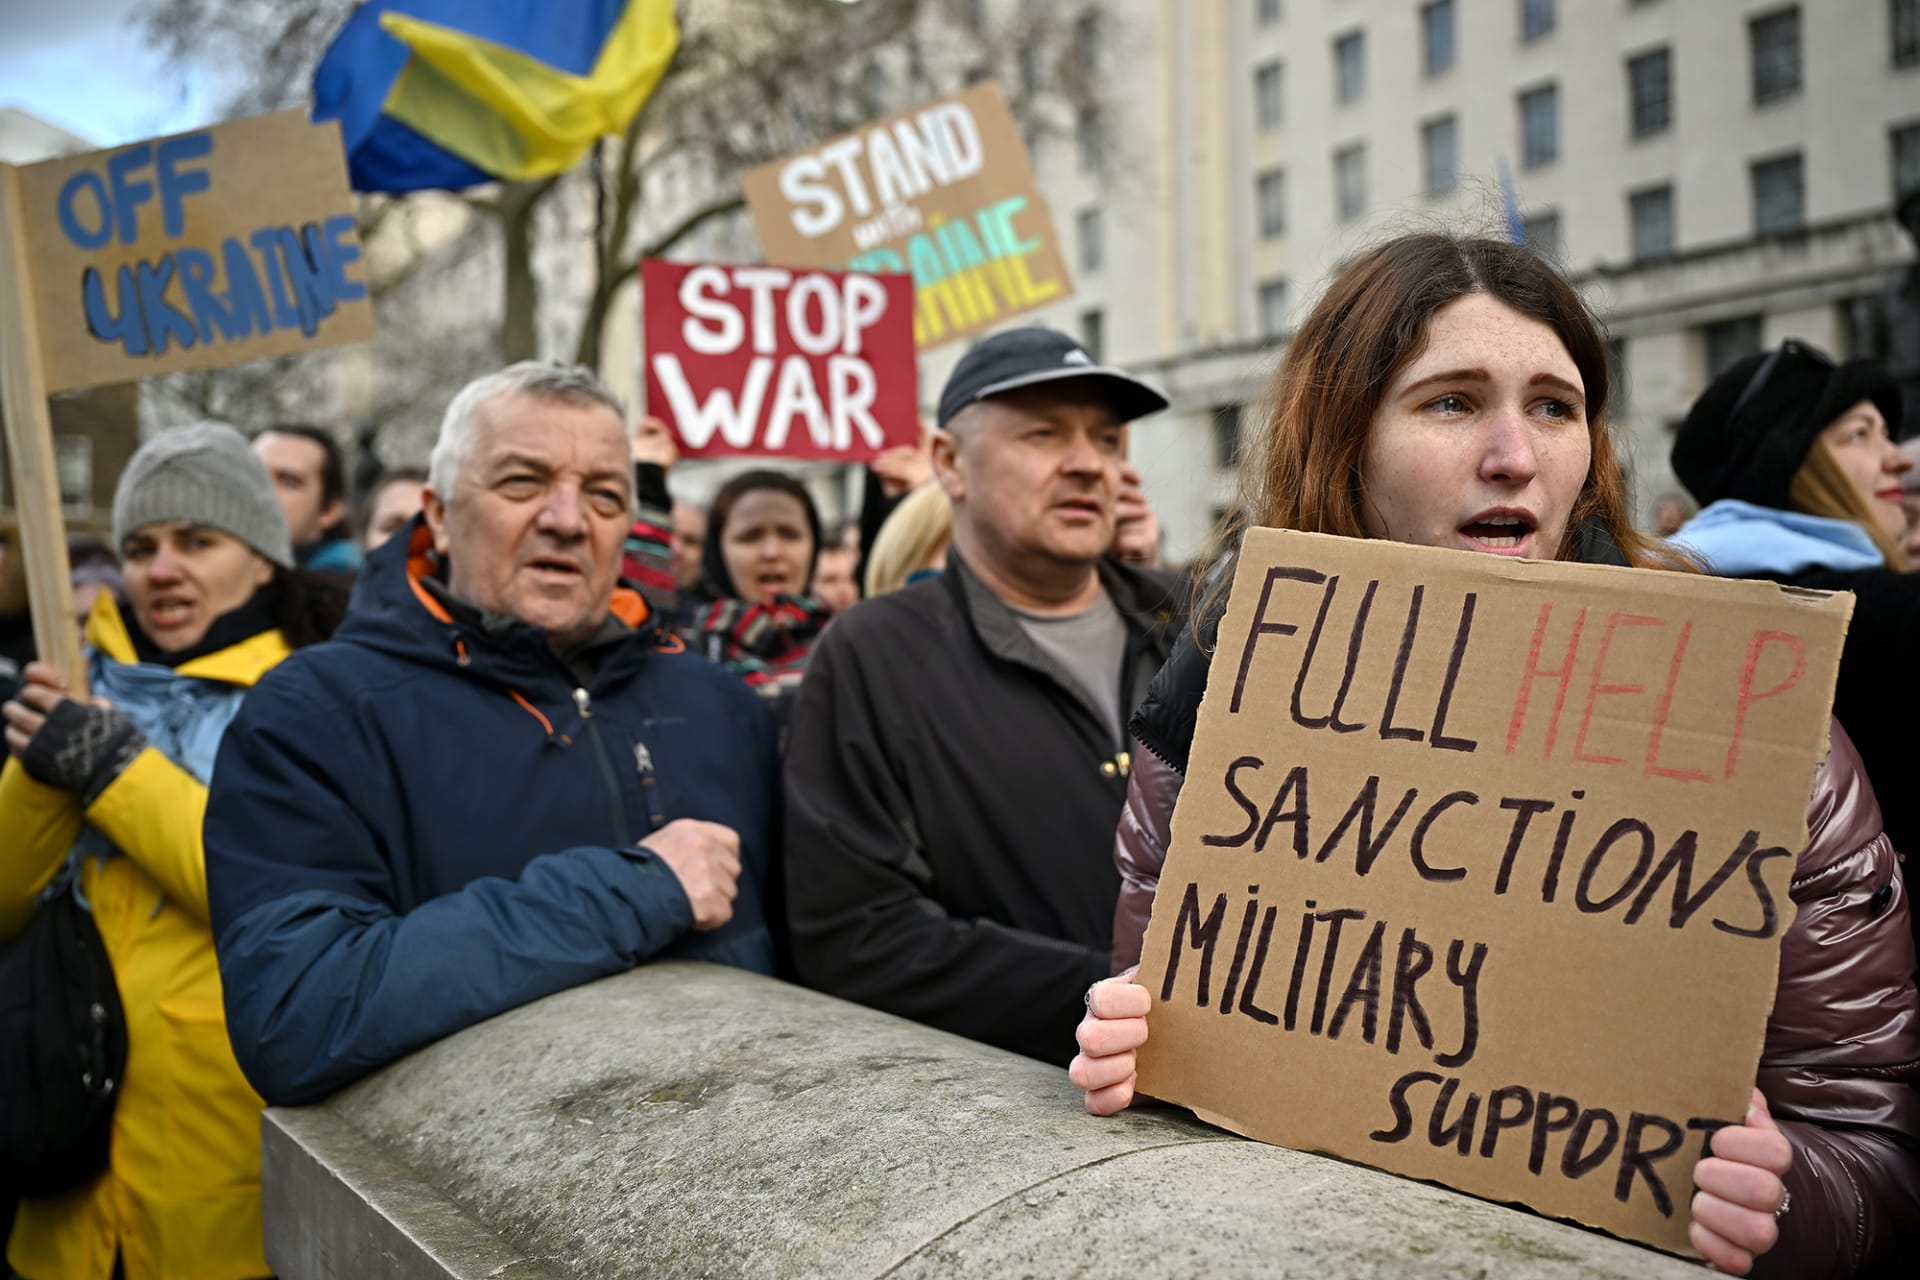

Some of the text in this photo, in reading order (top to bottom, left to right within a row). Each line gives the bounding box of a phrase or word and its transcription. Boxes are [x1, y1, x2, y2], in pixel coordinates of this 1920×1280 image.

[57, 132, 213, 250] OFF
[779, 102, 984, 236] STAND
[82, 213, 366, 357] UKRAINE
[680, 266, 887, 354] STOP
[652, 354, 884, 450] WAR
[1229, 566, 1808, 782] FULL HELP
